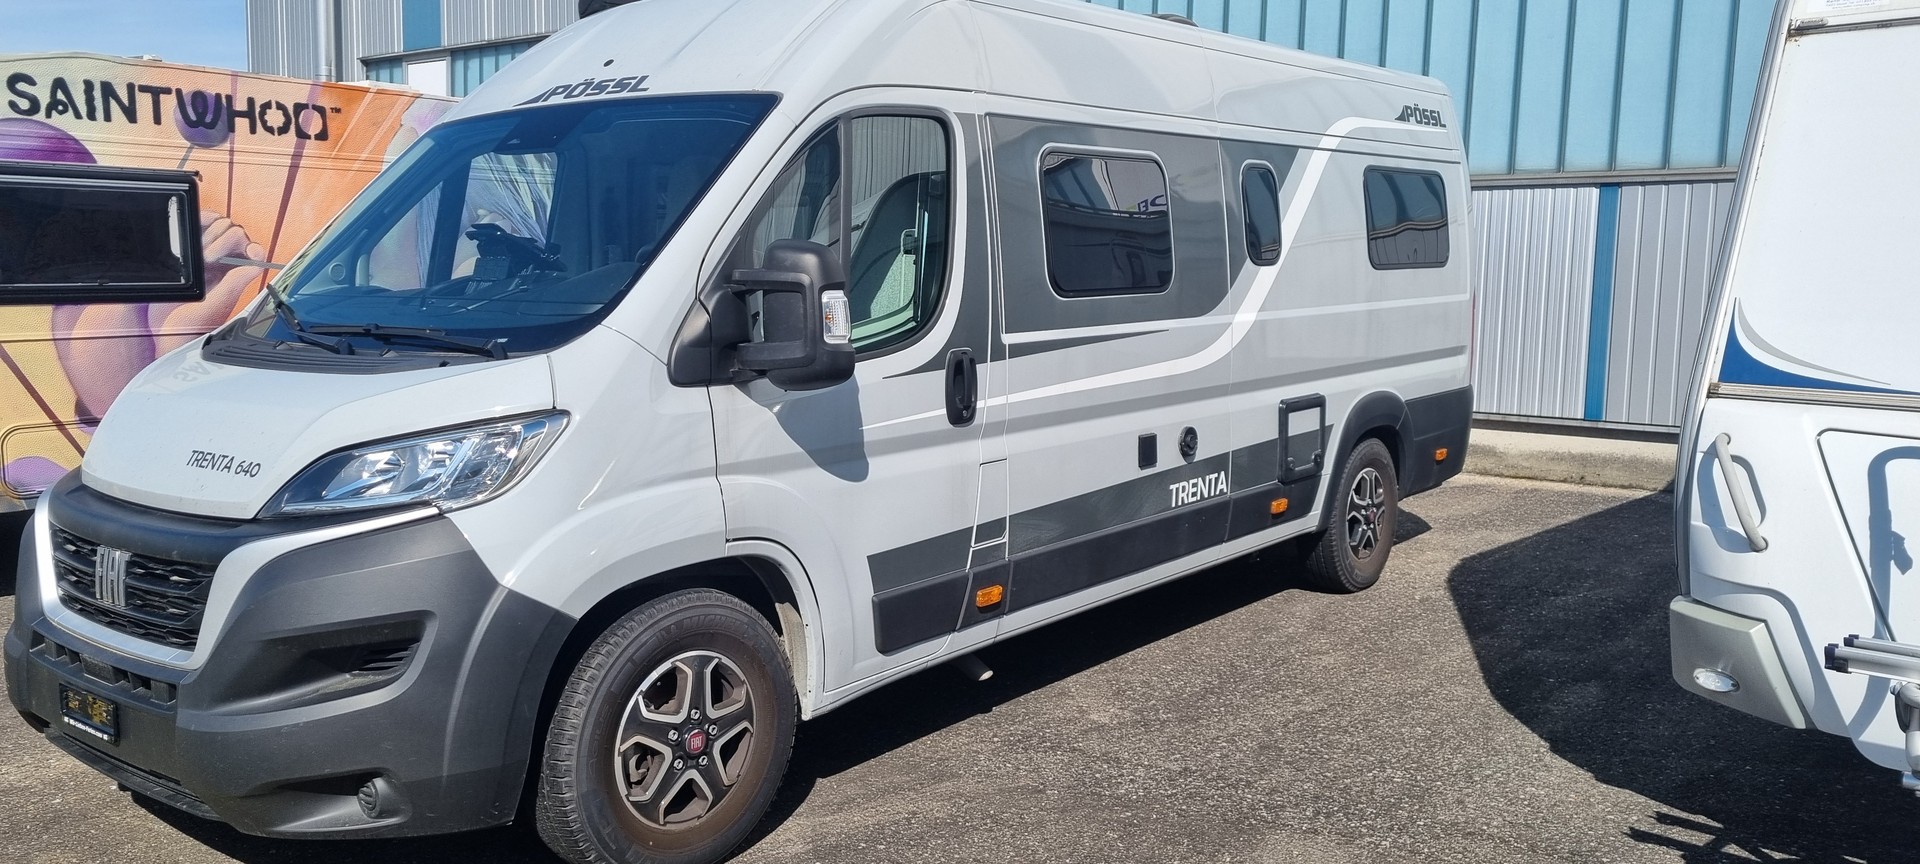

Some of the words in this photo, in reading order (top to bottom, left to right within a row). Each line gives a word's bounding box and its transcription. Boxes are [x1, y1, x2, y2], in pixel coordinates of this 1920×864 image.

[541, 74, 650, 103] PÖSSL
[1404, 102, 1447, 128] PÖSSL
[186, 449, 235, 474] TRENTA
[234, 460, 261, 478] 640
[1169, 470, 1228, 508] TRENTA
[95, 544, 132, 608] FIAT
[690, 735, 703, 750] FIAT
